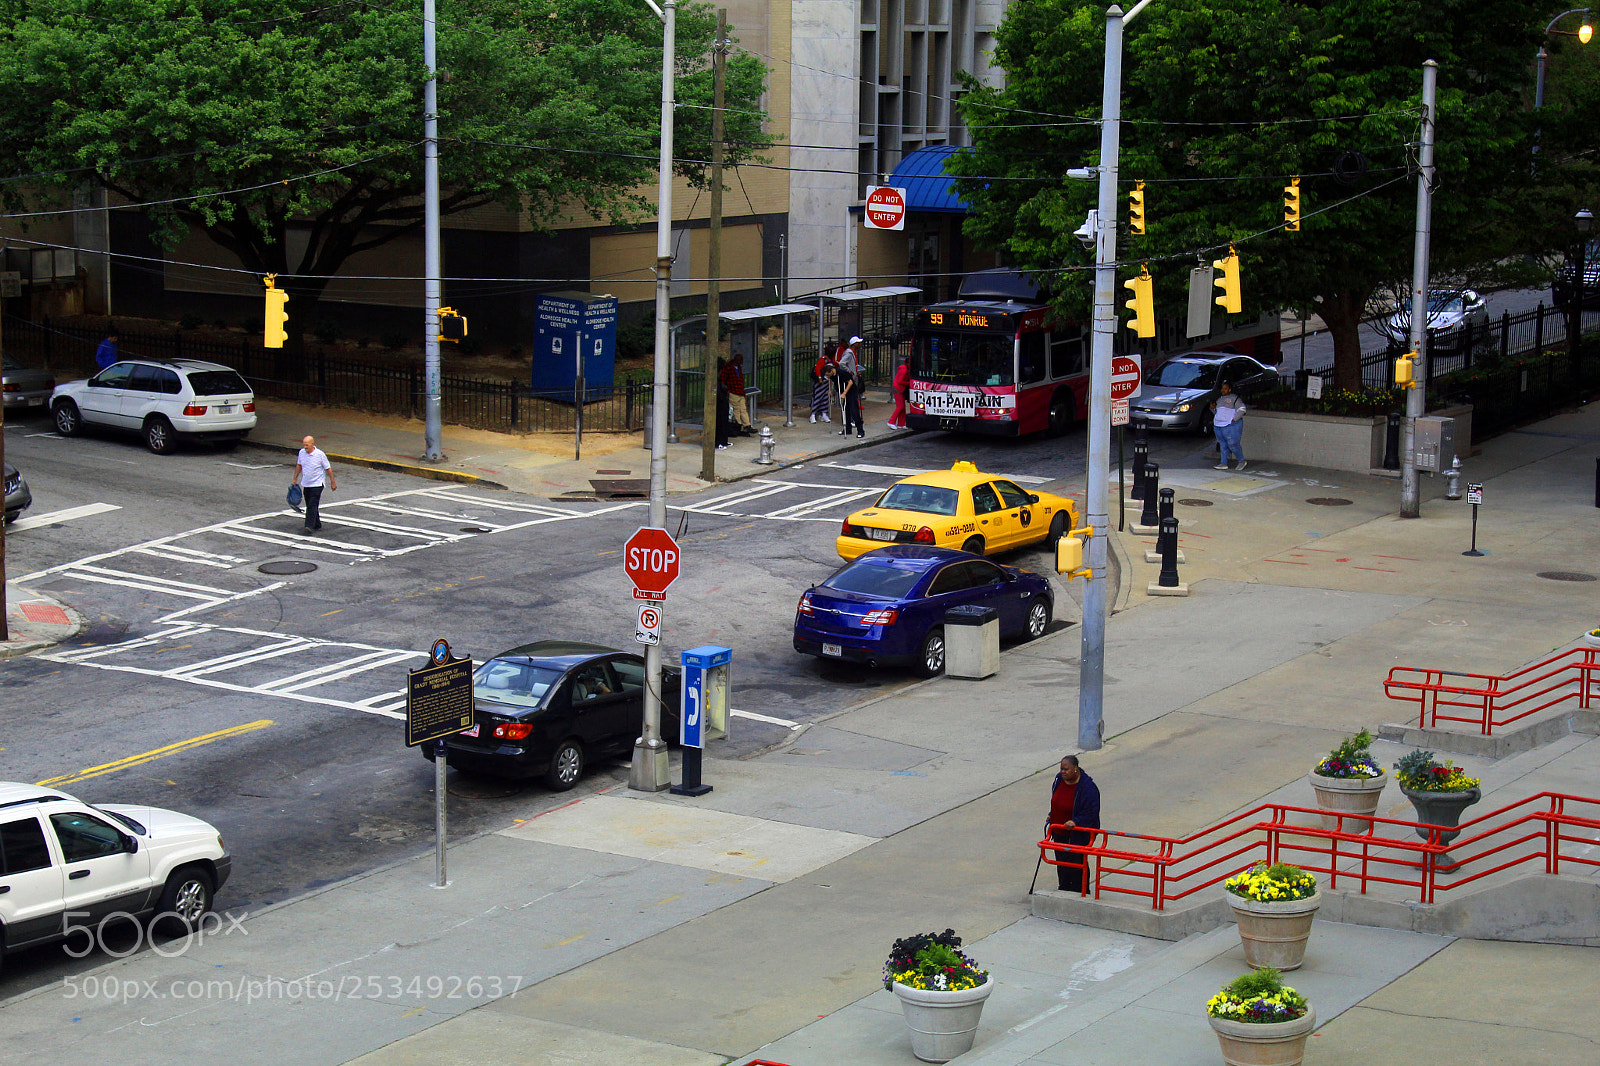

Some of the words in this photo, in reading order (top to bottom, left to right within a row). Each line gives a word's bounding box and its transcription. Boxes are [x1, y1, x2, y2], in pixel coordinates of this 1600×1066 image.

[874, 213, 895, 221] ENTER
[930, 313, 944, 325] 99
[958, 314, 989, 327] MONROE
[1119, 364, 1133, 372] NOT
[1111, 382, 1132, 392] NTER
[628, 547, 677, 573] STOP
[635, 590, 648, 598] ALL
[651, 591, 663, 599] WAY
